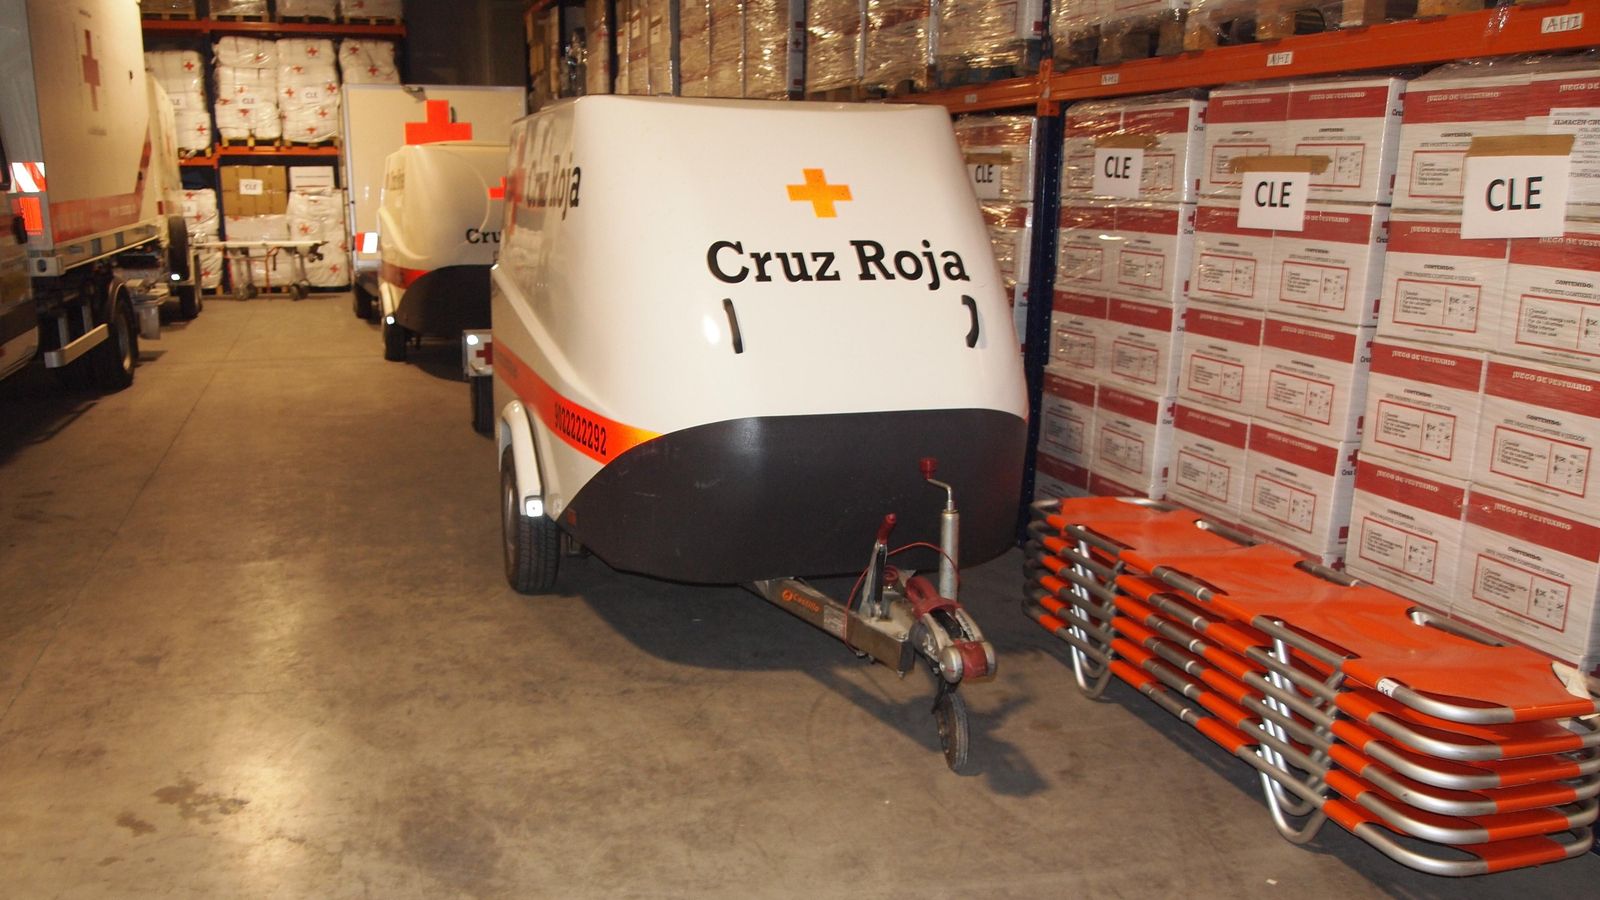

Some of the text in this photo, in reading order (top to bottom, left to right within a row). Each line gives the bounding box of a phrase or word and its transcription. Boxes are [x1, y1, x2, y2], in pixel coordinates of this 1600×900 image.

[975, 165, 993, 183] CLE
[1104, 156, 1132, 179] CLE
[1255, 181, 1292, 208] CLE
[1485, 176, 1543, 212] CLE
[466, 228, 501, 244] Cru
[706, 239, 970, 291] Cruz Roja
[1512, 371, 1593, 392] JUEGO DE VESTUARIO
